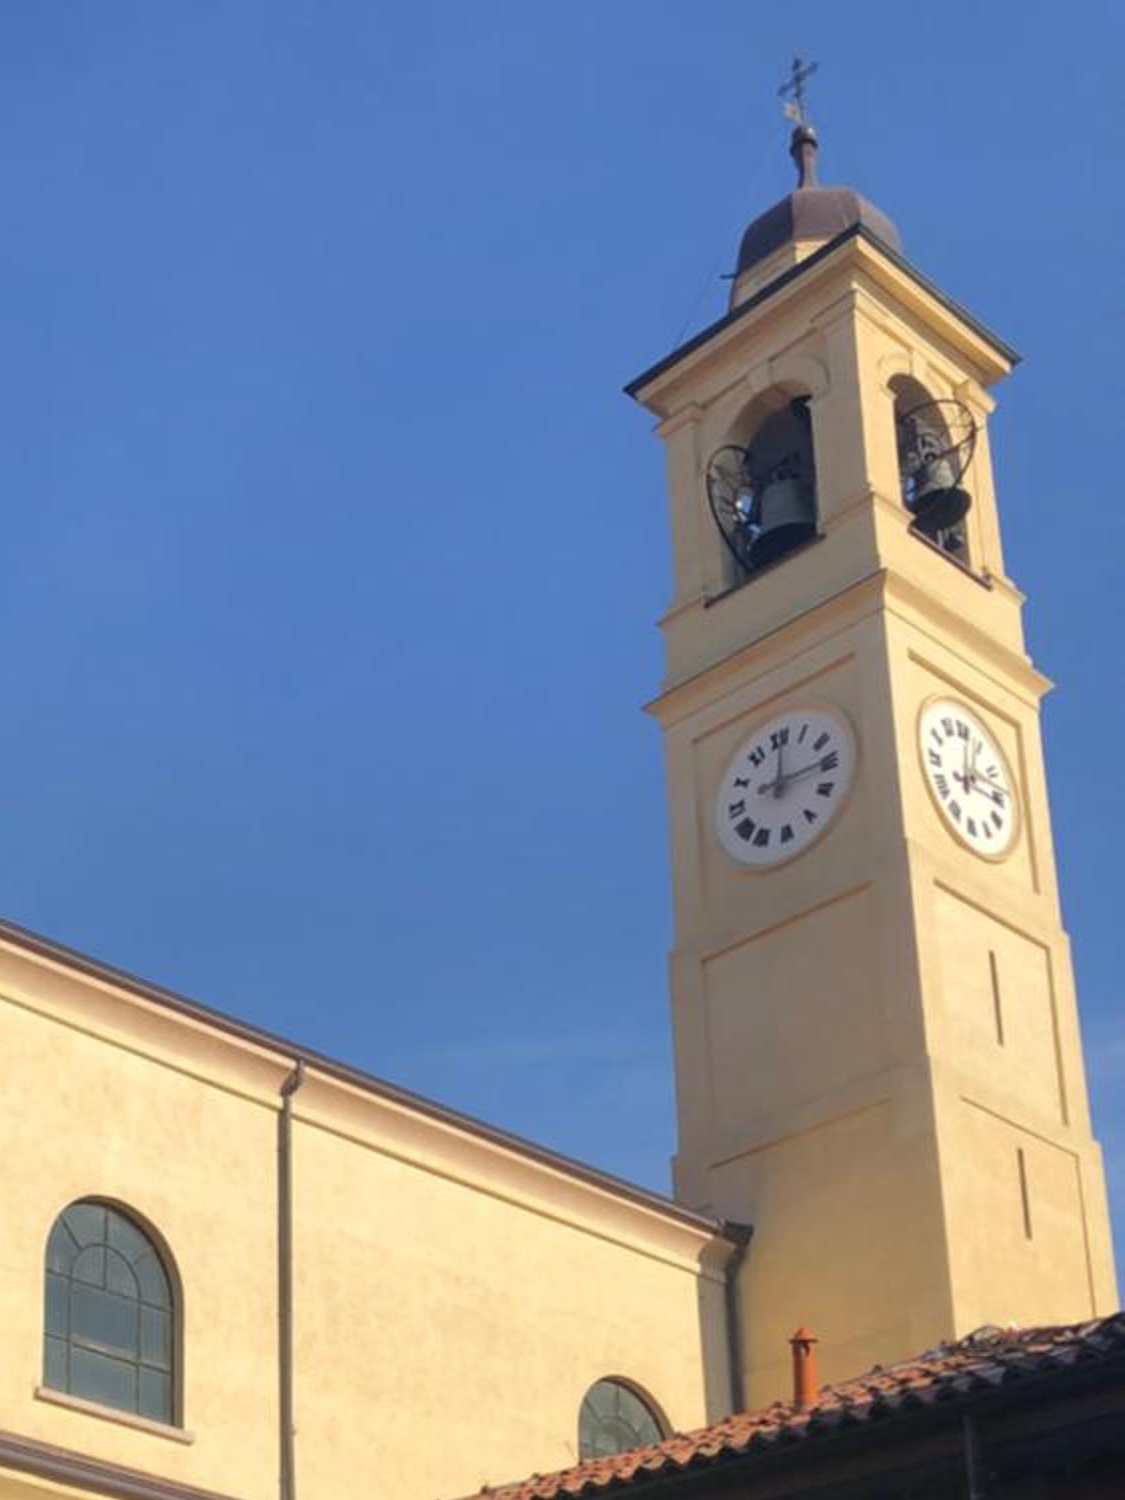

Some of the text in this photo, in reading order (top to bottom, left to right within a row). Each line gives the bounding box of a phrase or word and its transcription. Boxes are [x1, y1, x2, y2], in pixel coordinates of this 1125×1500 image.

[770, 726, 790, 752] XII
[798, 724, 809, 744] I
[748, 746, 766, 768] XI
[819, 750, 840, 773] III
[733, 776, 751, 789] X
[729, 799, 747, 820] IX
[803, 808, 818, 825] V
